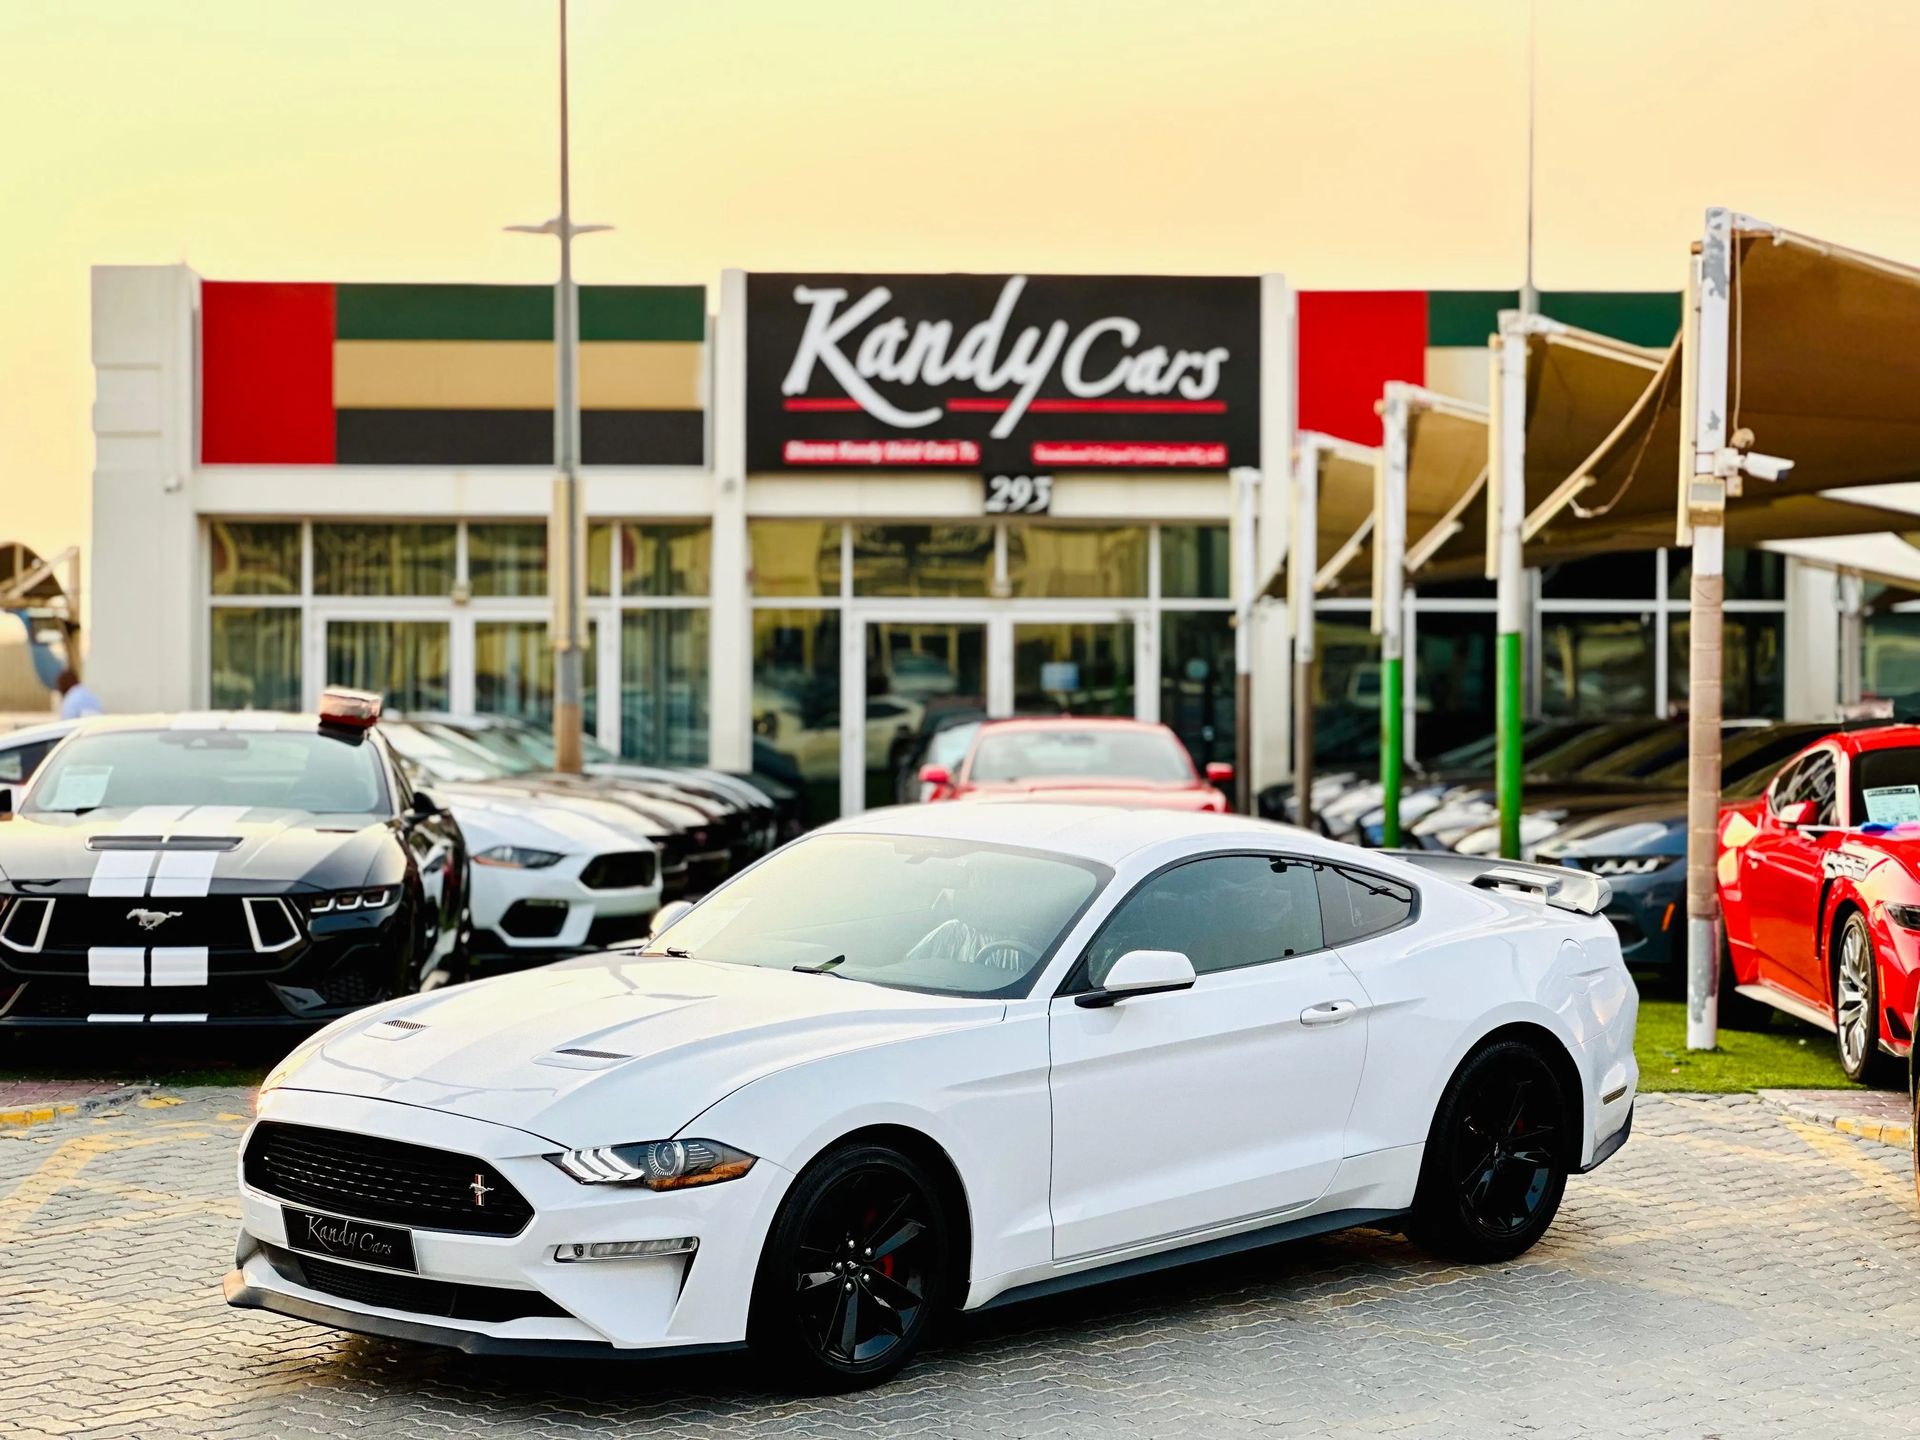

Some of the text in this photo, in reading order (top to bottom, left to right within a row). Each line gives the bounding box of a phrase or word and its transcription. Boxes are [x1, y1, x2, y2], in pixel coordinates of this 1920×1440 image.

[781, 275, 1230, 438] Kandy Cars
[985, 474, 1054, 513] 295
[305, 1213, 393, 1258] Kandy Cars
